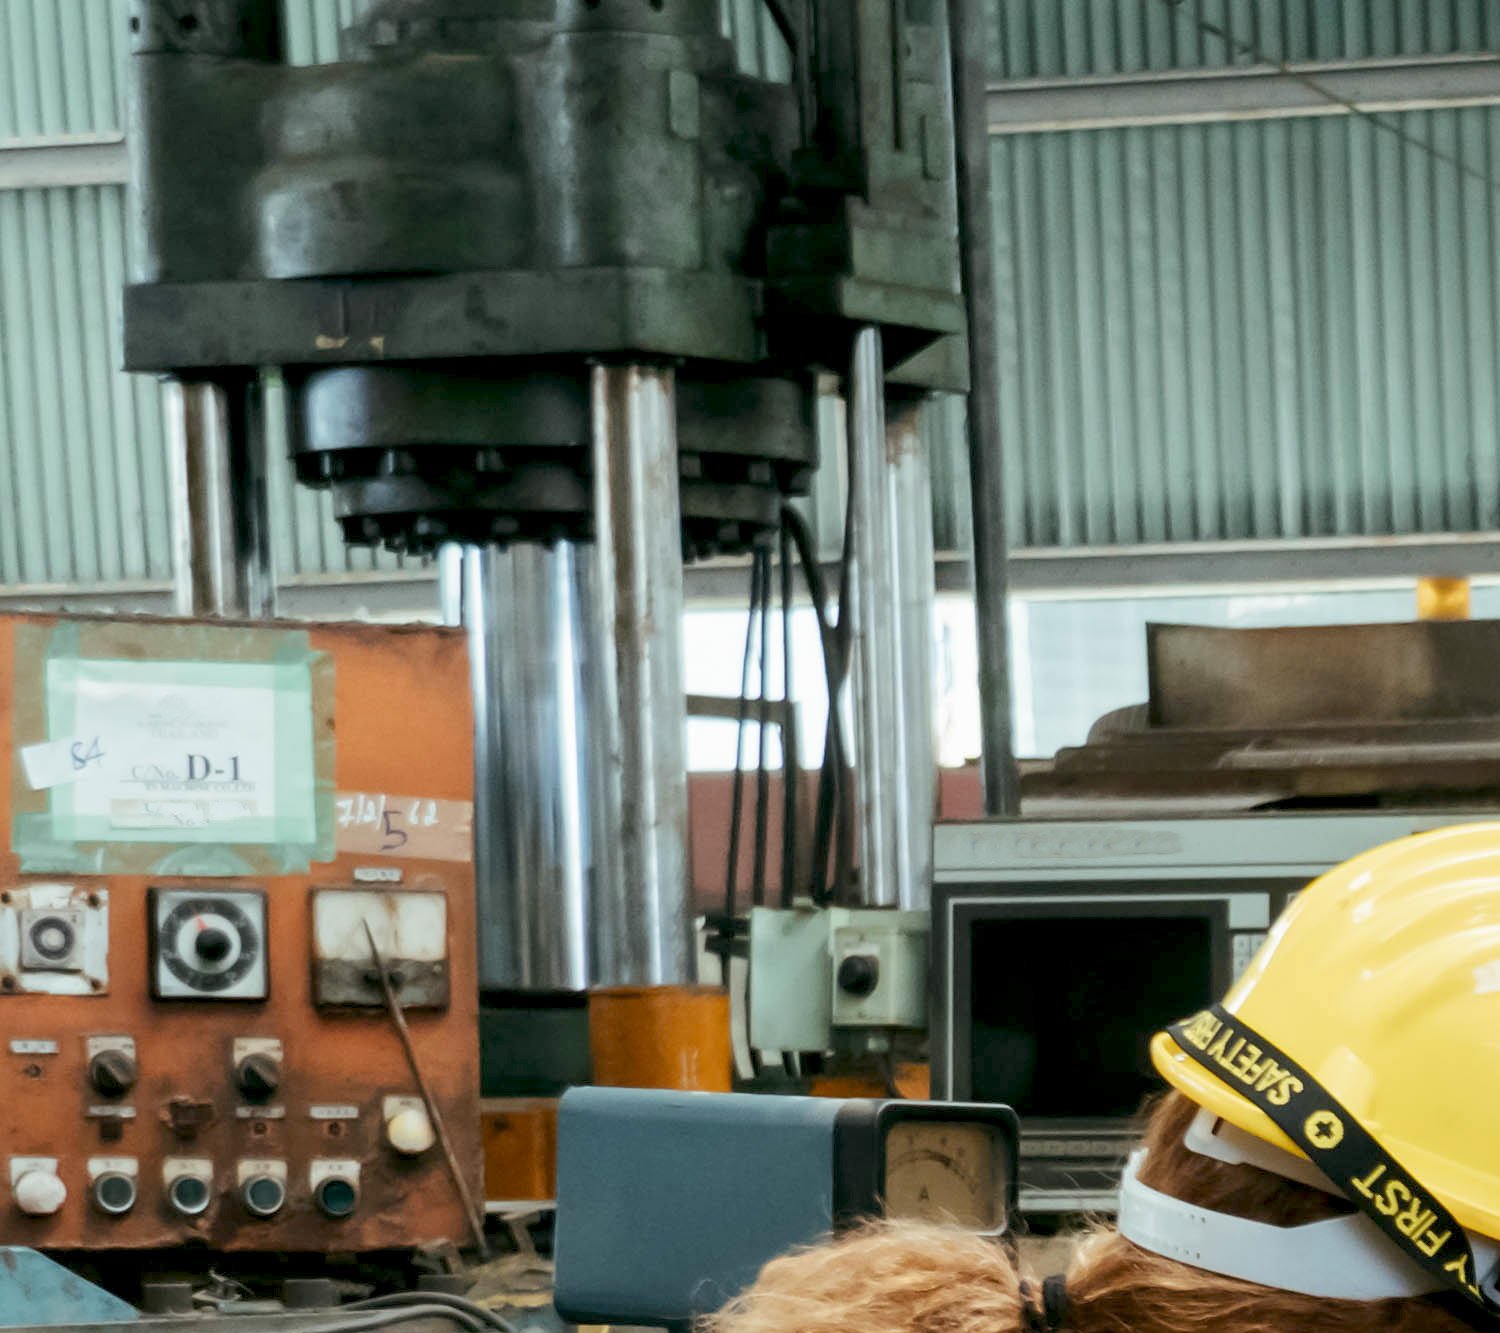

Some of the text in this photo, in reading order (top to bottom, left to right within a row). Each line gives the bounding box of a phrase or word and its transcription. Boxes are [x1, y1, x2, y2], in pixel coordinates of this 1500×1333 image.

[187, 754, 241, 781] D-1
[381, 809, 408, 851] 5
[1206, 1027, 1304, 1106] SAFETY
[1351, 1163, 1453, 1258] FIRST
